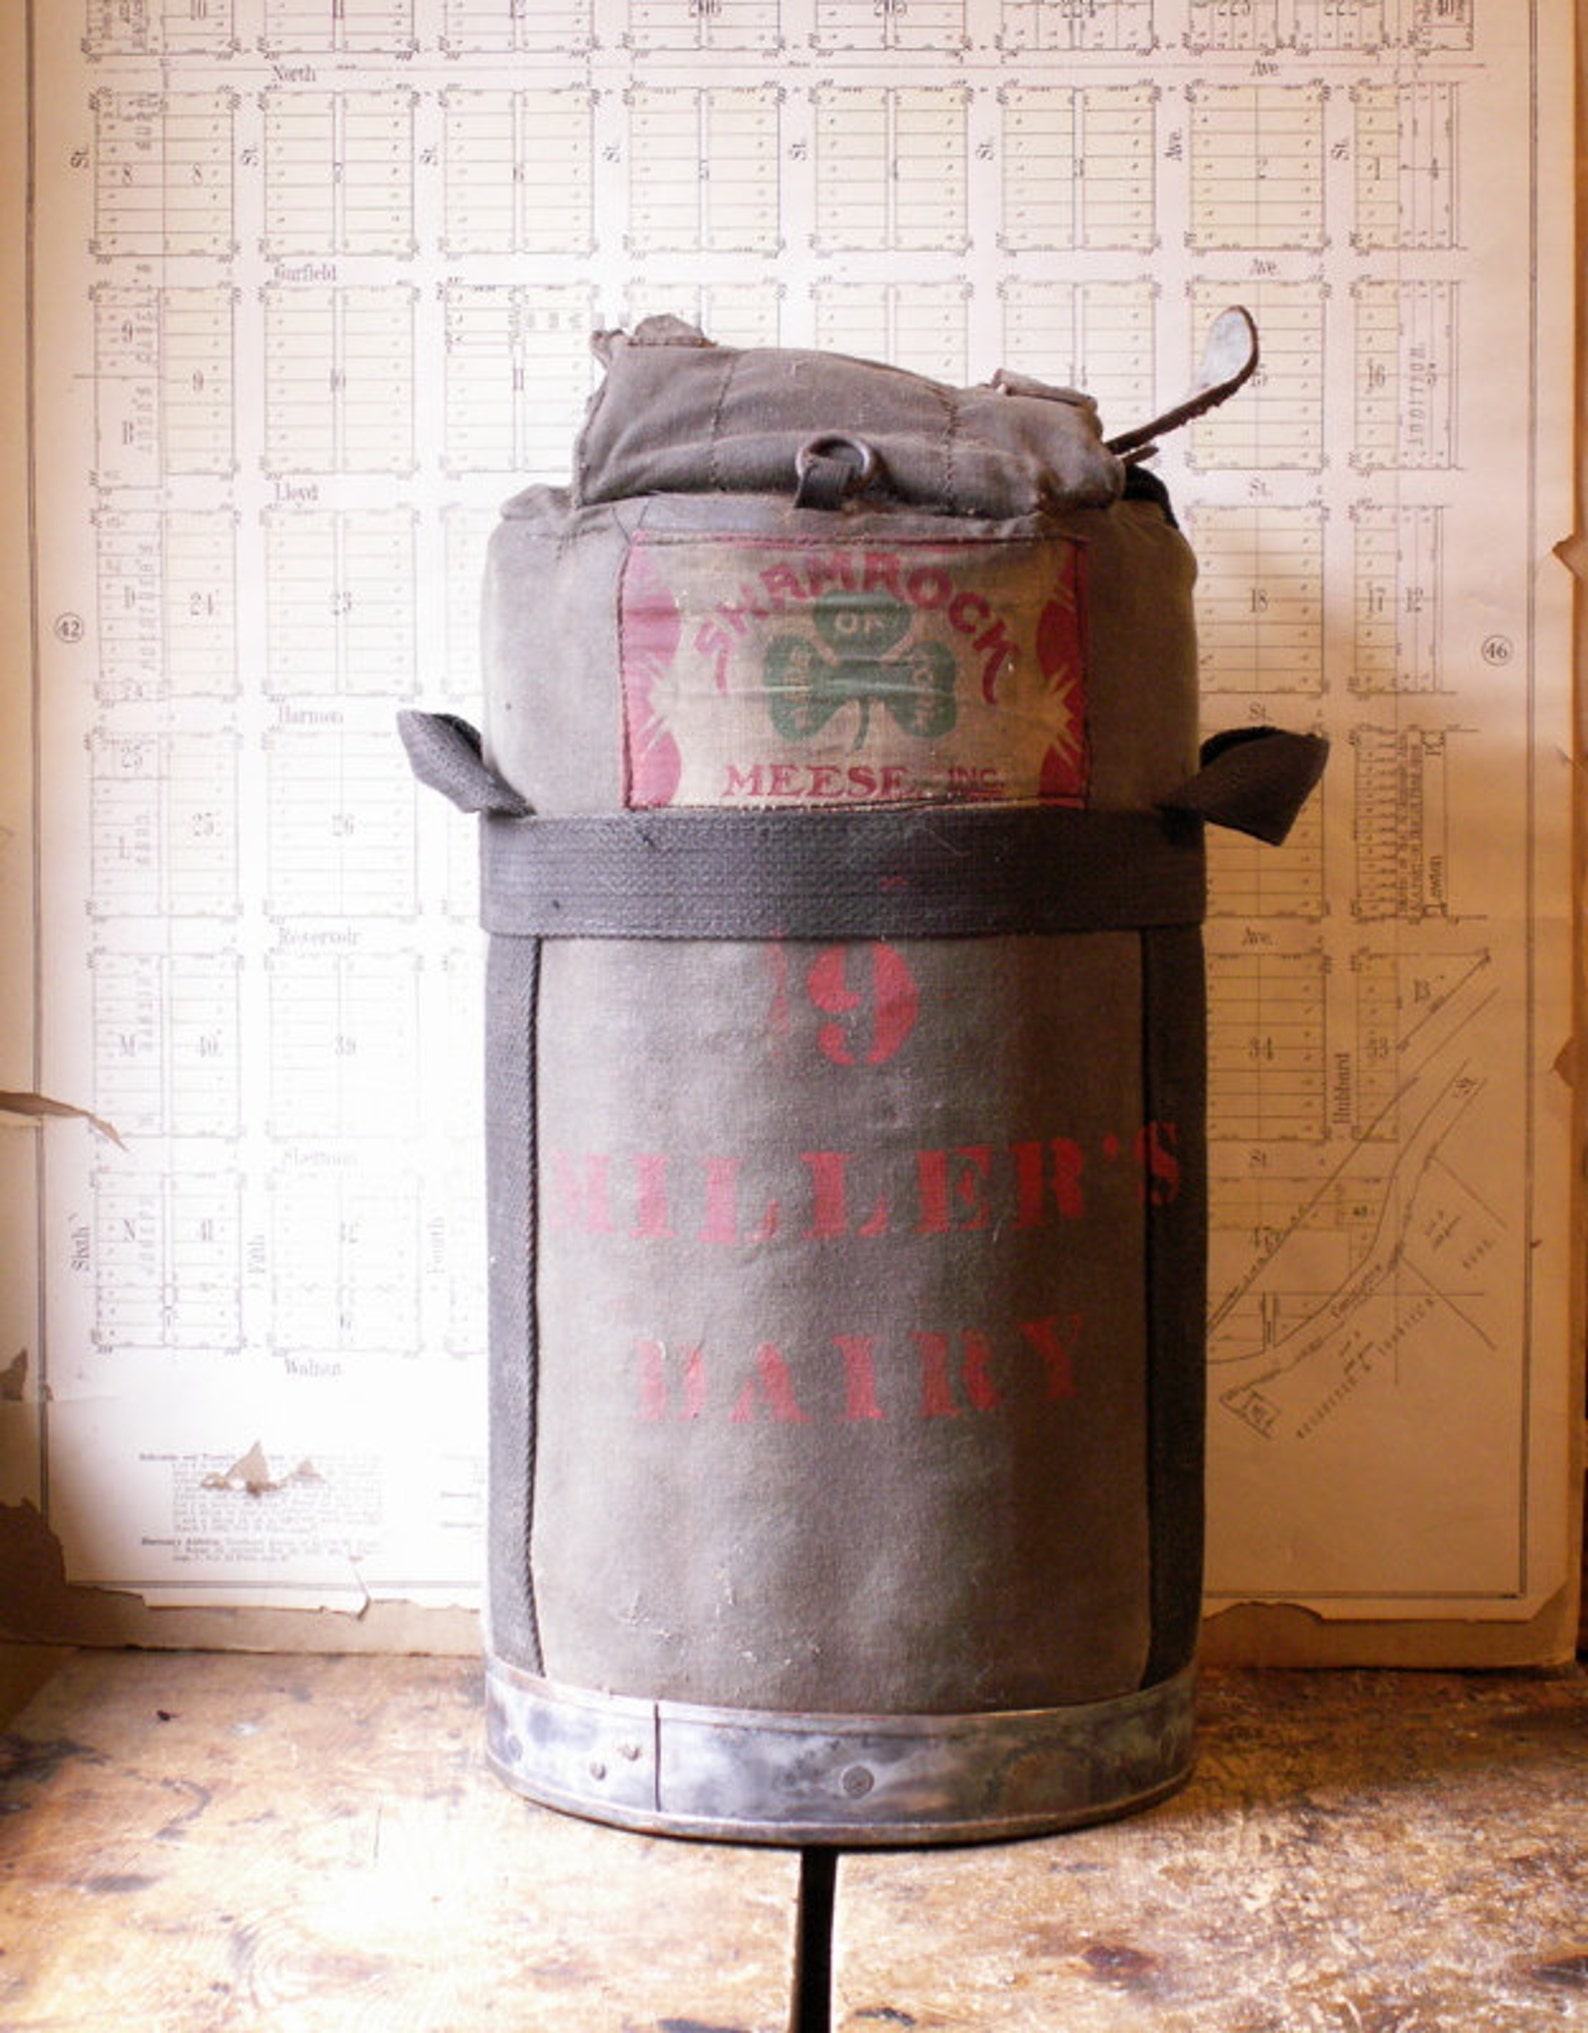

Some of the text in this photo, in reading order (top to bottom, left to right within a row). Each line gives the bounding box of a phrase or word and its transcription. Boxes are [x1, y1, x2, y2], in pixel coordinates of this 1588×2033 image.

[273, 64, 316, 83] North
[1249, 588, 1269, 613] 18
[548, 1122, 1183, 1244] MILLER'S
